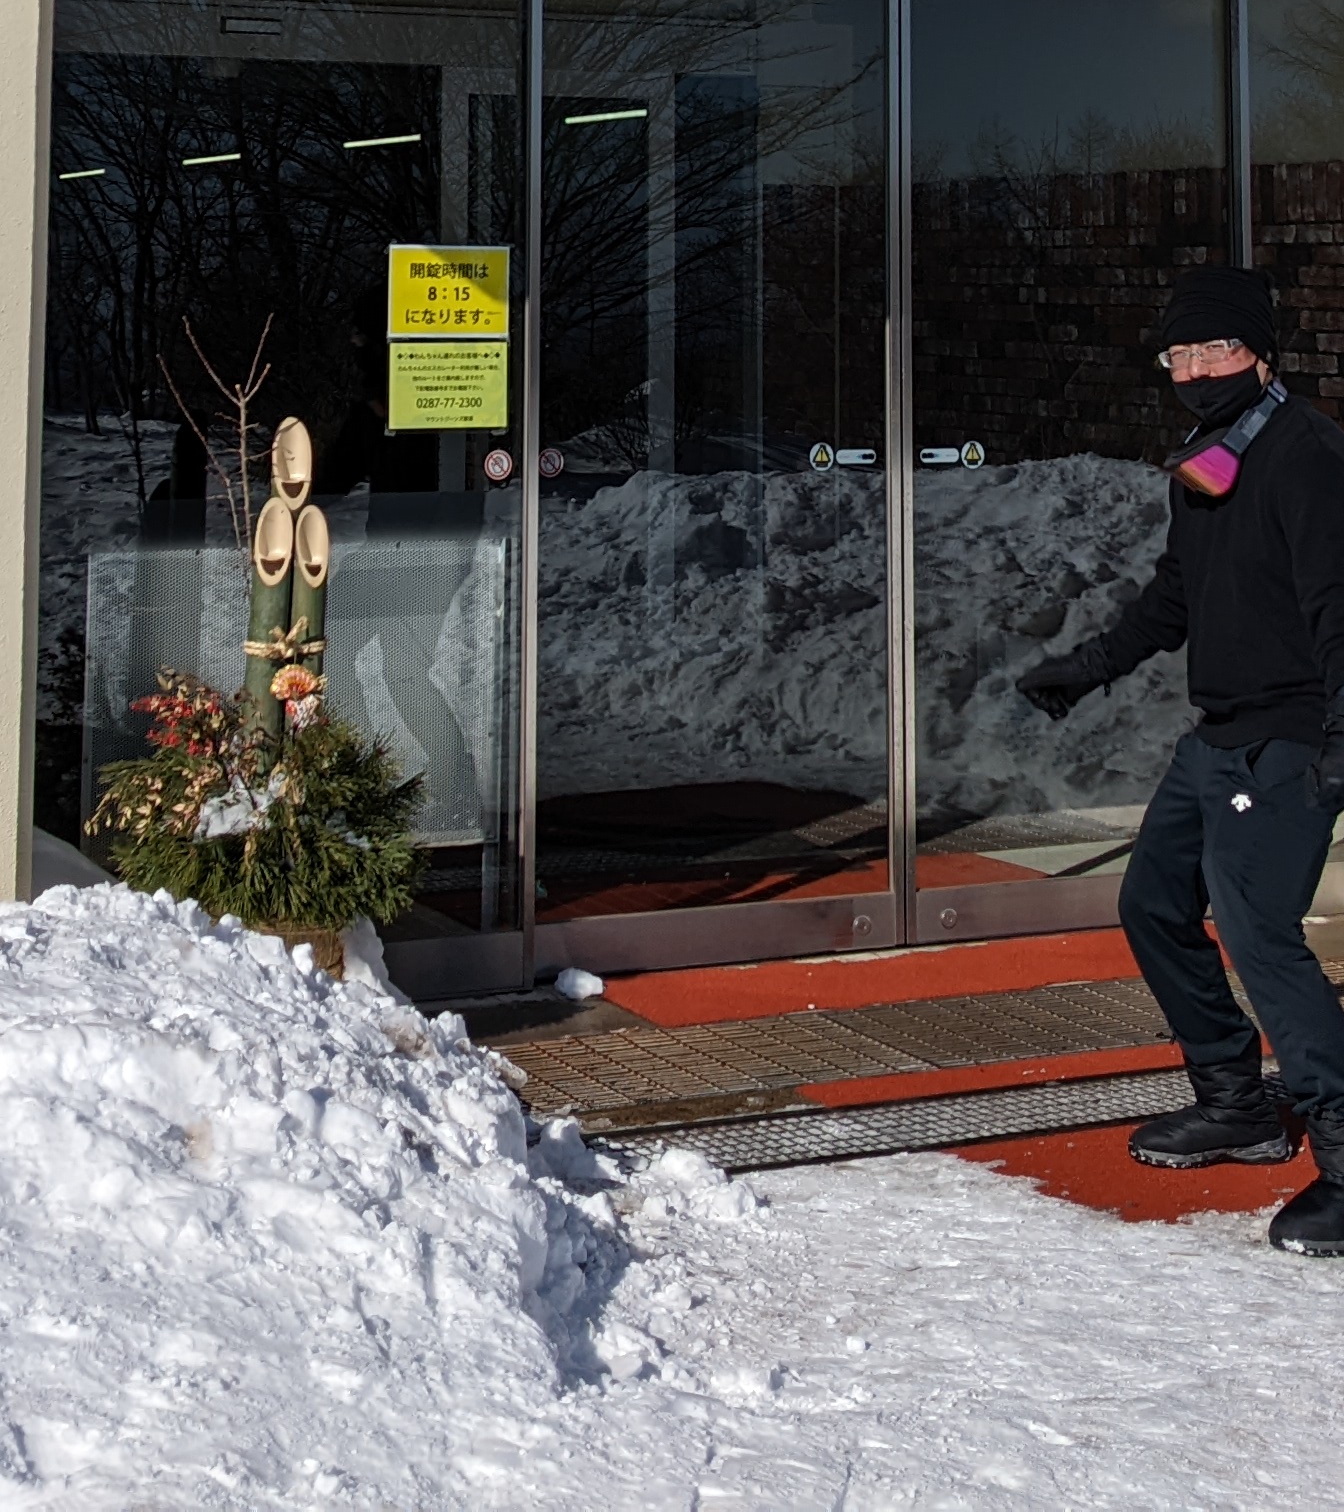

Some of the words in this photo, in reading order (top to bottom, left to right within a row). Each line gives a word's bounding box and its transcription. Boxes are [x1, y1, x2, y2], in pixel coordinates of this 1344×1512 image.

[409, 262, 490, 279] 開錠時間は
[405, 307, 491, 325] になります。
[416, 397, 483, 409] 0287-77-2300
